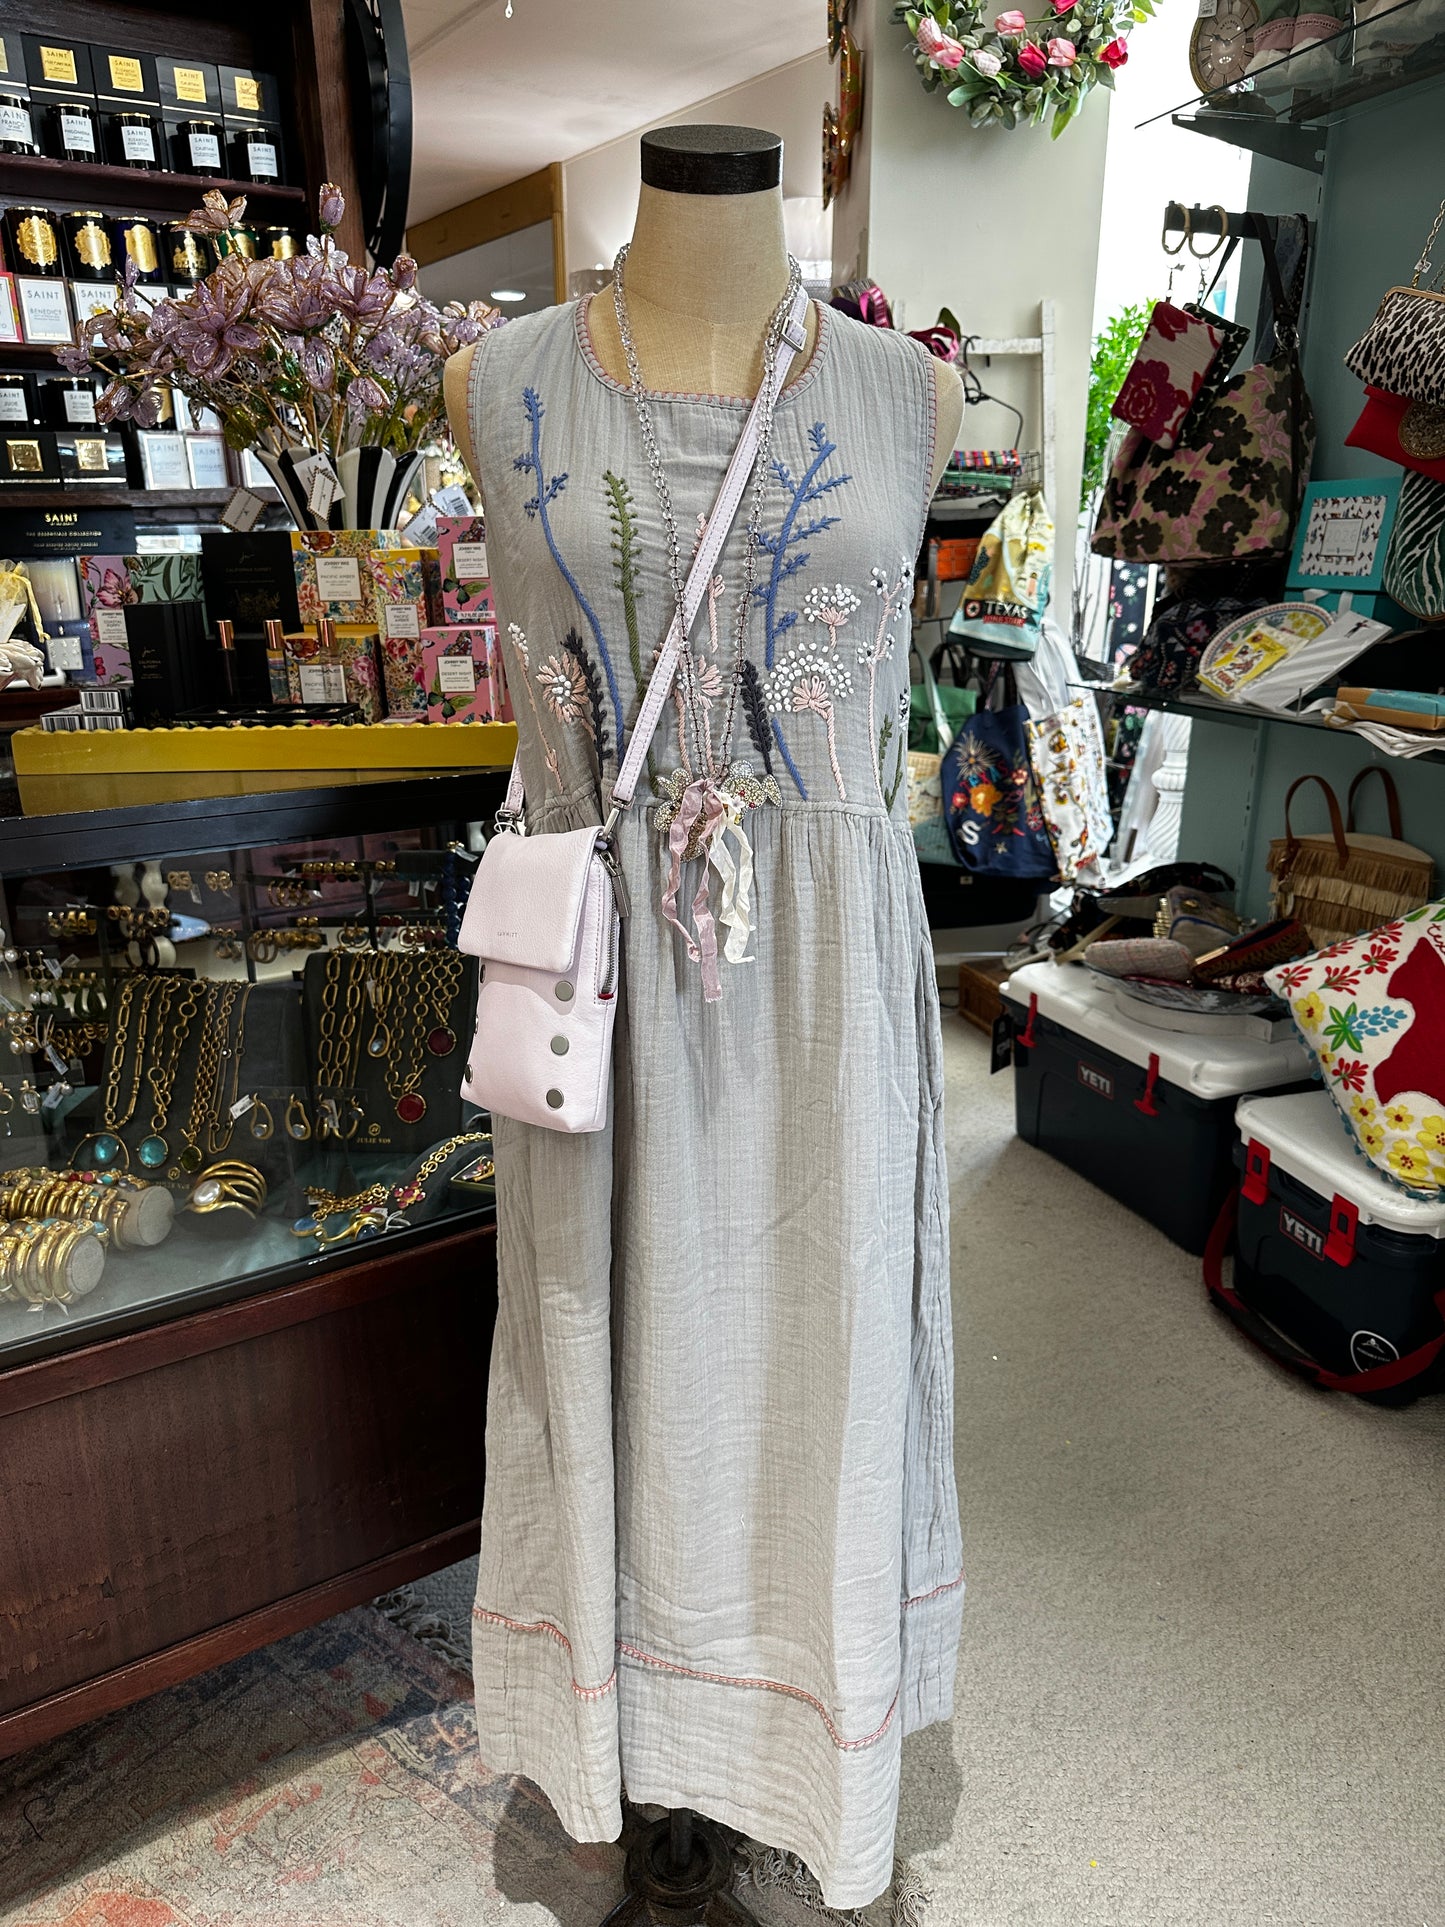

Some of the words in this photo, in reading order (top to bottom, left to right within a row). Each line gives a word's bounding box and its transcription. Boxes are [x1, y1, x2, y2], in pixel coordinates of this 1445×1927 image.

[46, 50, 67, 58] SAINT
[179, 71, 199, 79] SAINT
[66, 118, 87, 126] SAINT
[27, 290, 60, 300] SAINT
[81, 290, 112, 299] SAINT
[150, 443, 179, 452] SAINT
[194, 447, 221, 456] SAINT
[44, 512, 78, 523] SAINT
[984, 600, 1029, 619] TEXAS
[1079, 1065, 1111, 1095] YETI
[1283, 1211, 1323, 1254] YETI
